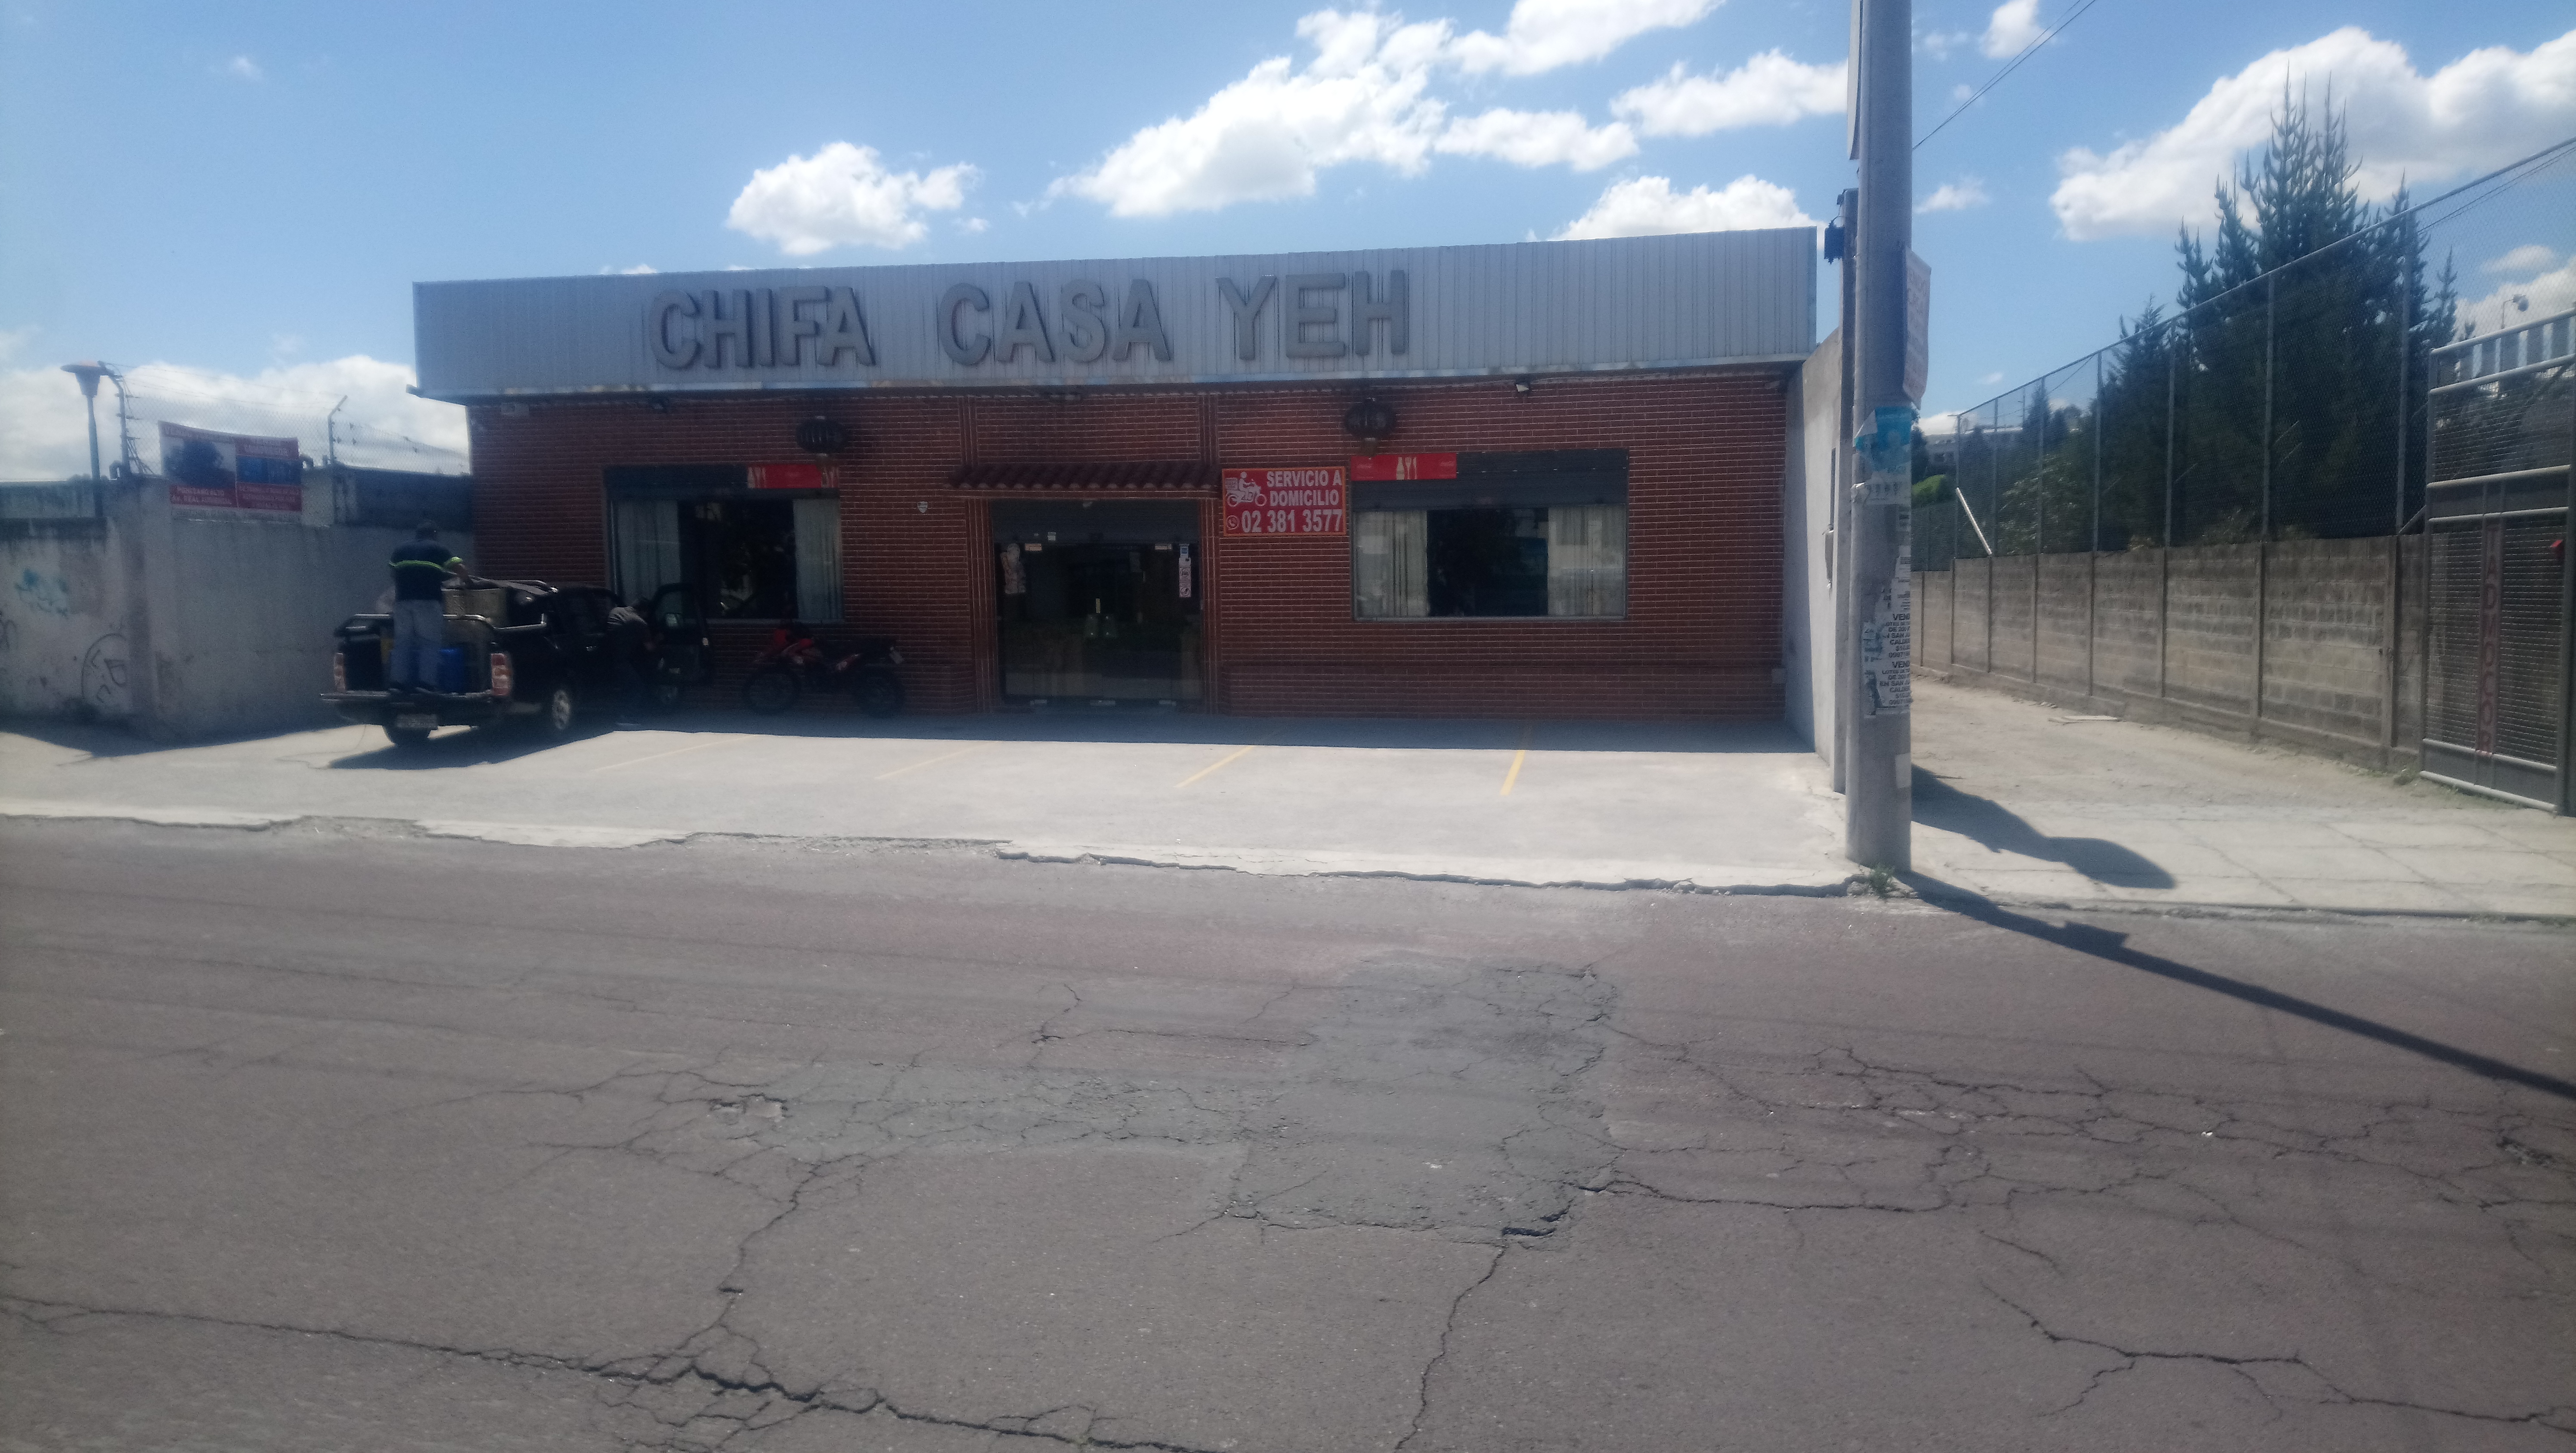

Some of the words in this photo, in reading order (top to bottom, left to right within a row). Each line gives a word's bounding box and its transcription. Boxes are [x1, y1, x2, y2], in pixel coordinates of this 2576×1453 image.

[649, 284, 877, 371] CHIFA
[938, 278, 1172, 366] CASA
[1215, 269, 1406, 361] YEH
[1266, 470, 1329, 487] SERVICIO
[1332, 470, 1343, 486] A
[1269, 489, 1339, 507] DOMICILIO
[1242, 510, 1262, 533] 02
[1266, 510, 1295, 532] 381
[1302, 509, 1343, 532] 3577
